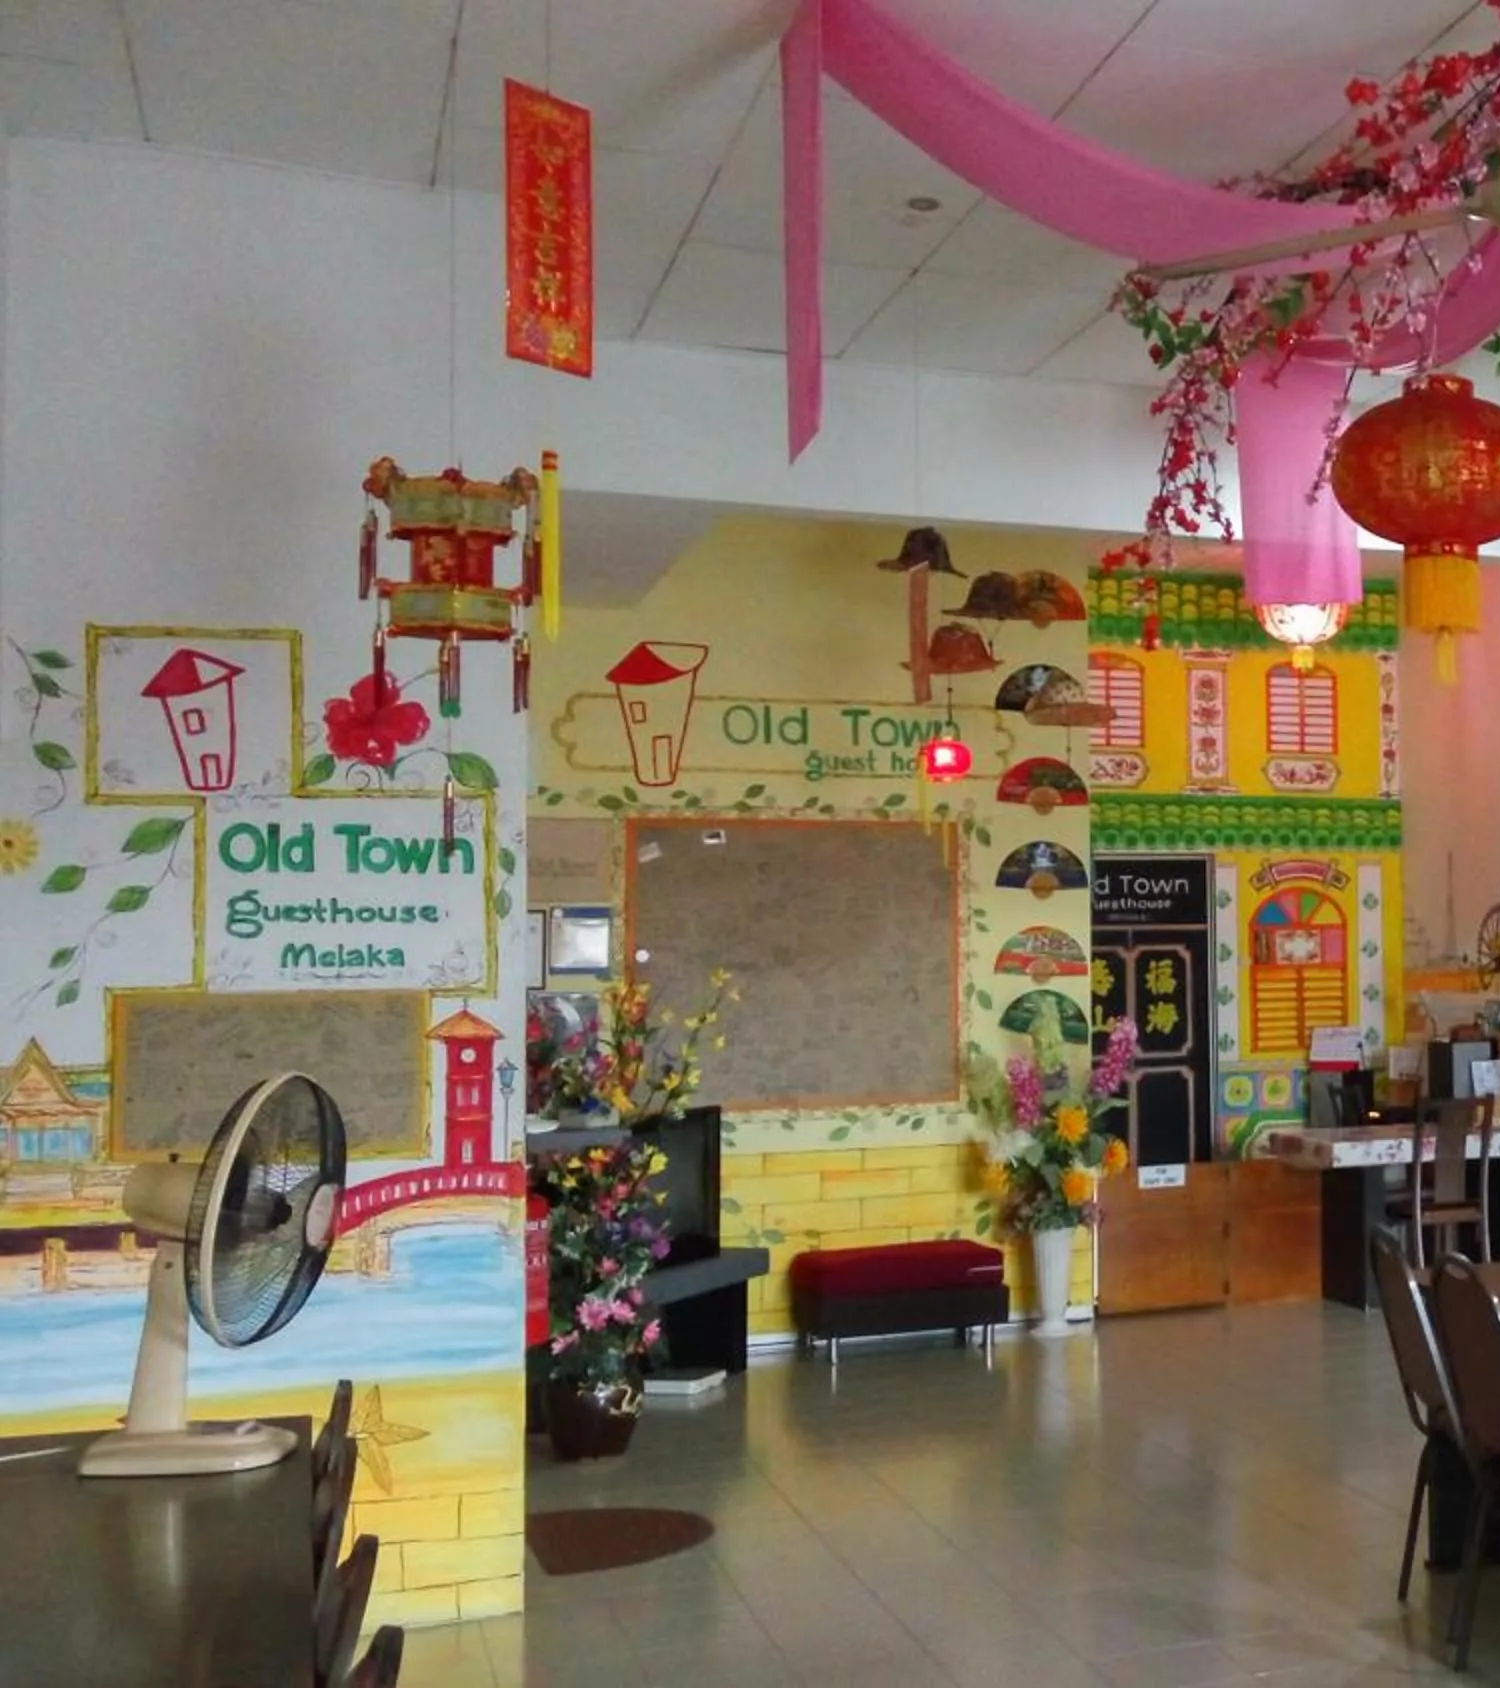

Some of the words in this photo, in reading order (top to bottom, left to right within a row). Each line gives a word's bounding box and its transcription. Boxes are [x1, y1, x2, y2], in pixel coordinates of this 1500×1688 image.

[722, 704, 809, 745] Old
[804, 750, 878, 781] guest
[218, 822, 315, 874] Old
[332, 823, 475, 875] Town
[1118, 874, 1190, 896] Town
[225, 889, 439, 939] guesthouse
[1094, 897, 1173, 911] uesthouse
[280, 942, 406, 969] Melaka
